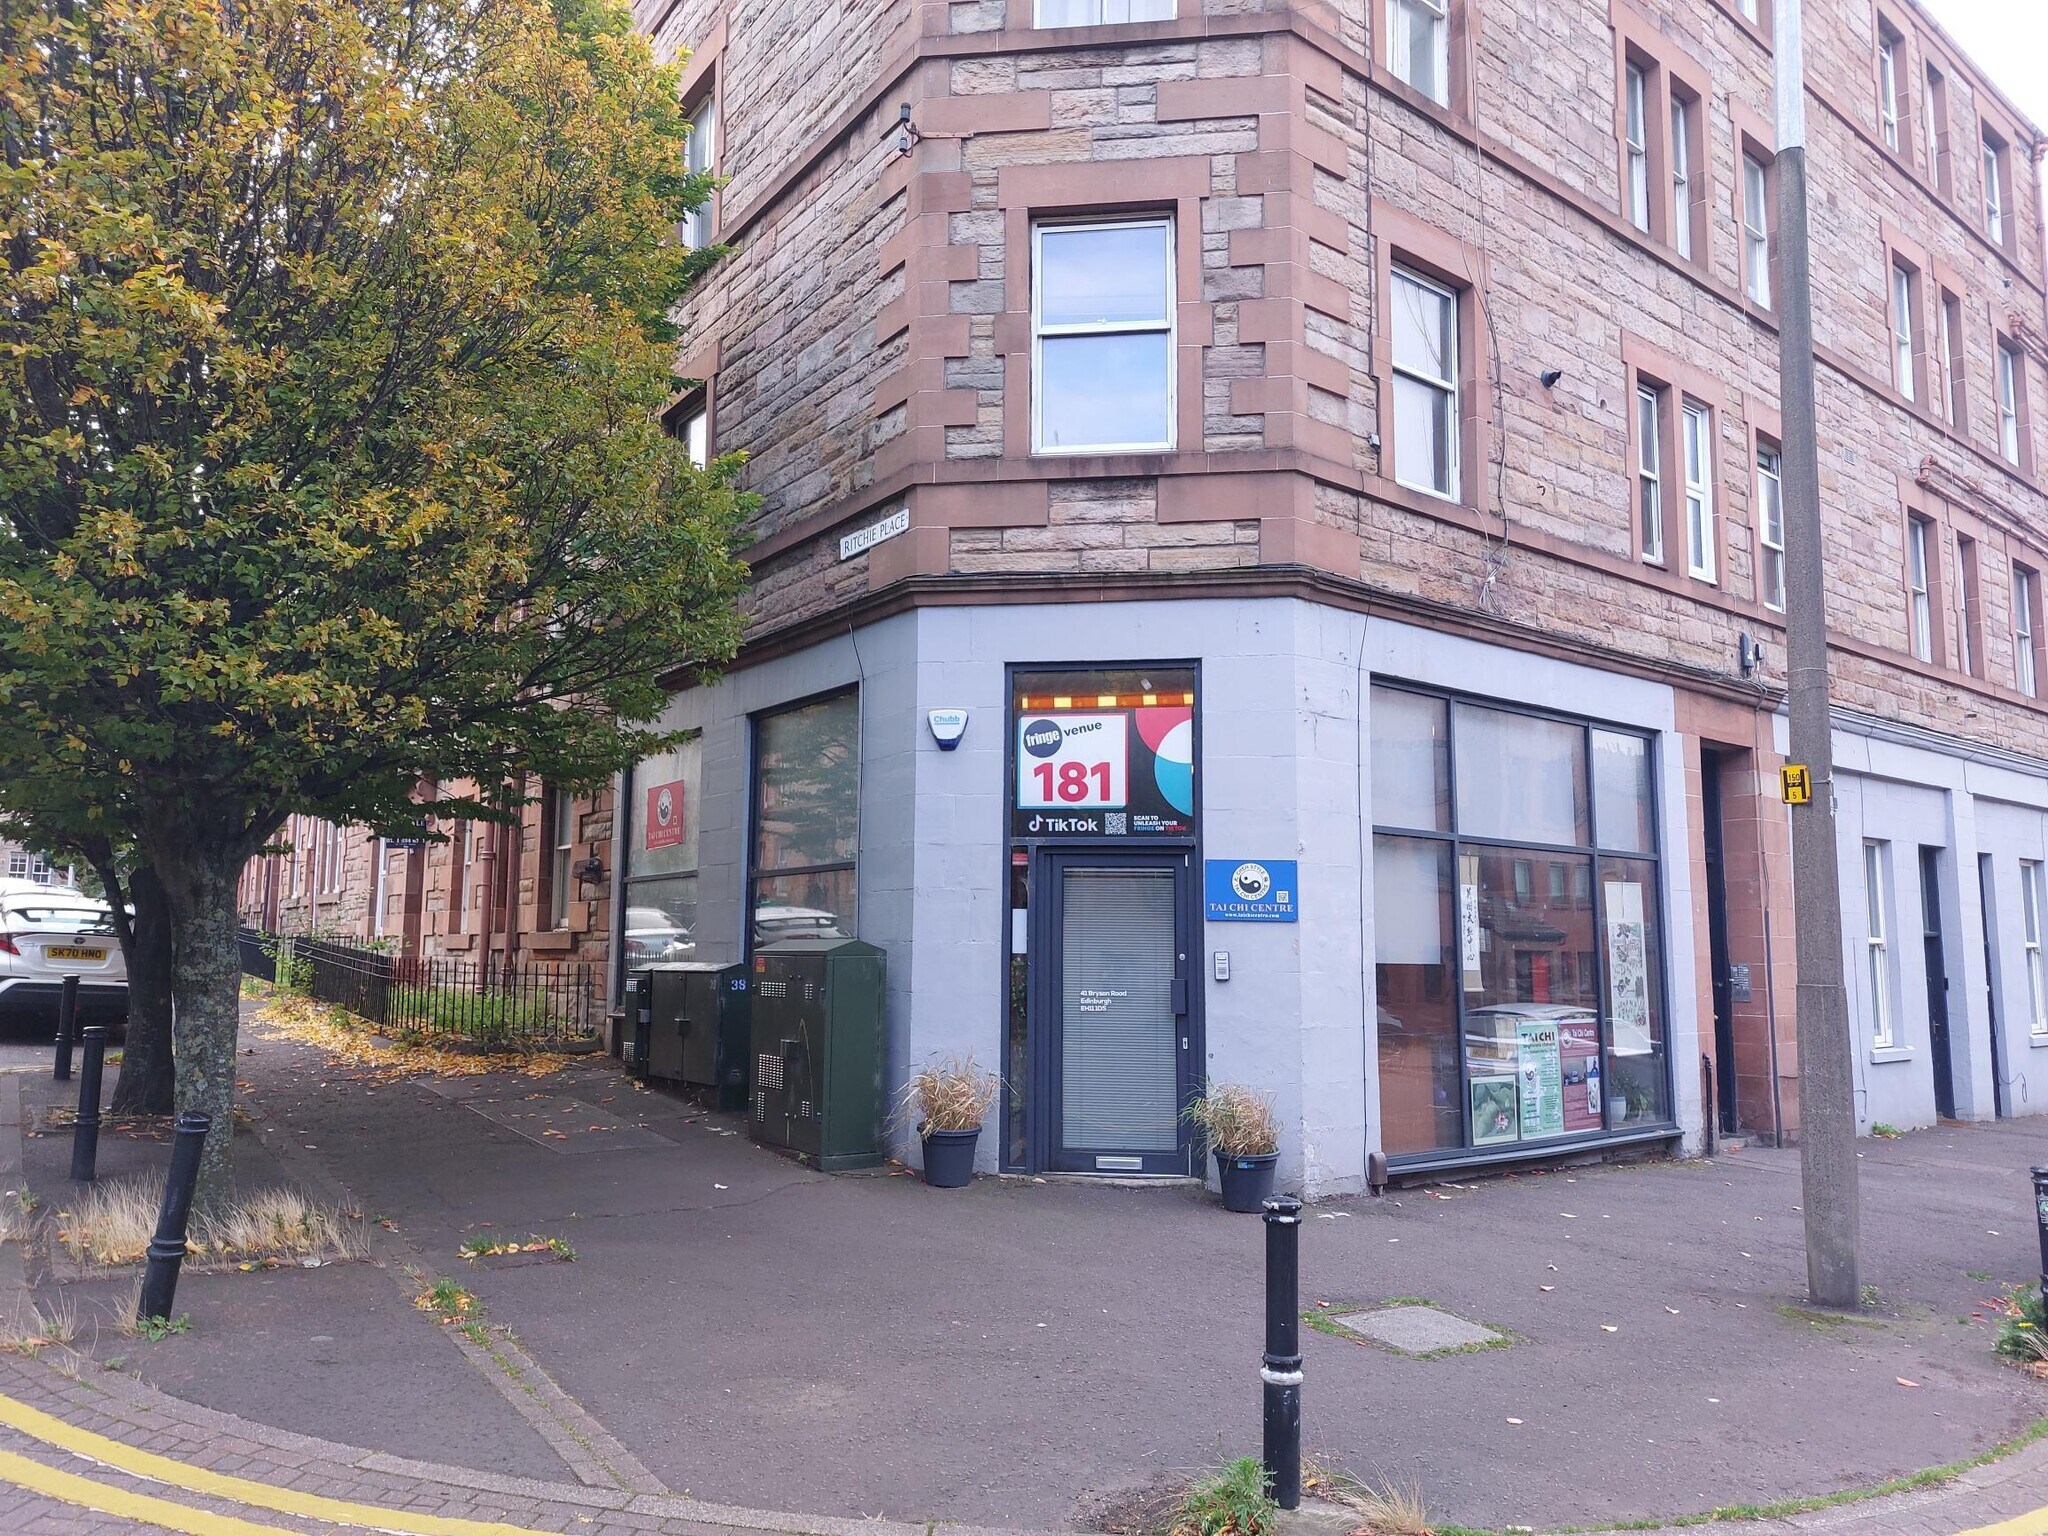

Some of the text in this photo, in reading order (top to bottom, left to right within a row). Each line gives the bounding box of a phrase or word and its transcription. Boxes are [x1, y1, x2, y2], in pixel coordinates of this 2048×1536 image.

[844, 514, 906, 554] RITCHIE PLACE
[933, 715, 960, 723] Chubb
[1025, 721, 1103, 748] fringe venue
[1033, 761, 1111, 802] 181
[1788, 774, 1800, 782] 150
[1792, 791, 1797, 799] 5
[1045, 818, 1099, 832] TikTok
[1210, 903, 1294, 912] TAI CHI CENTRE
[51, 947, 79, 958] SK70
[731, 979, 746, 991] 38
[1088, 990, 1110, 998] Bryson
[1080, 998, 1112, 1006] Edinburgh
